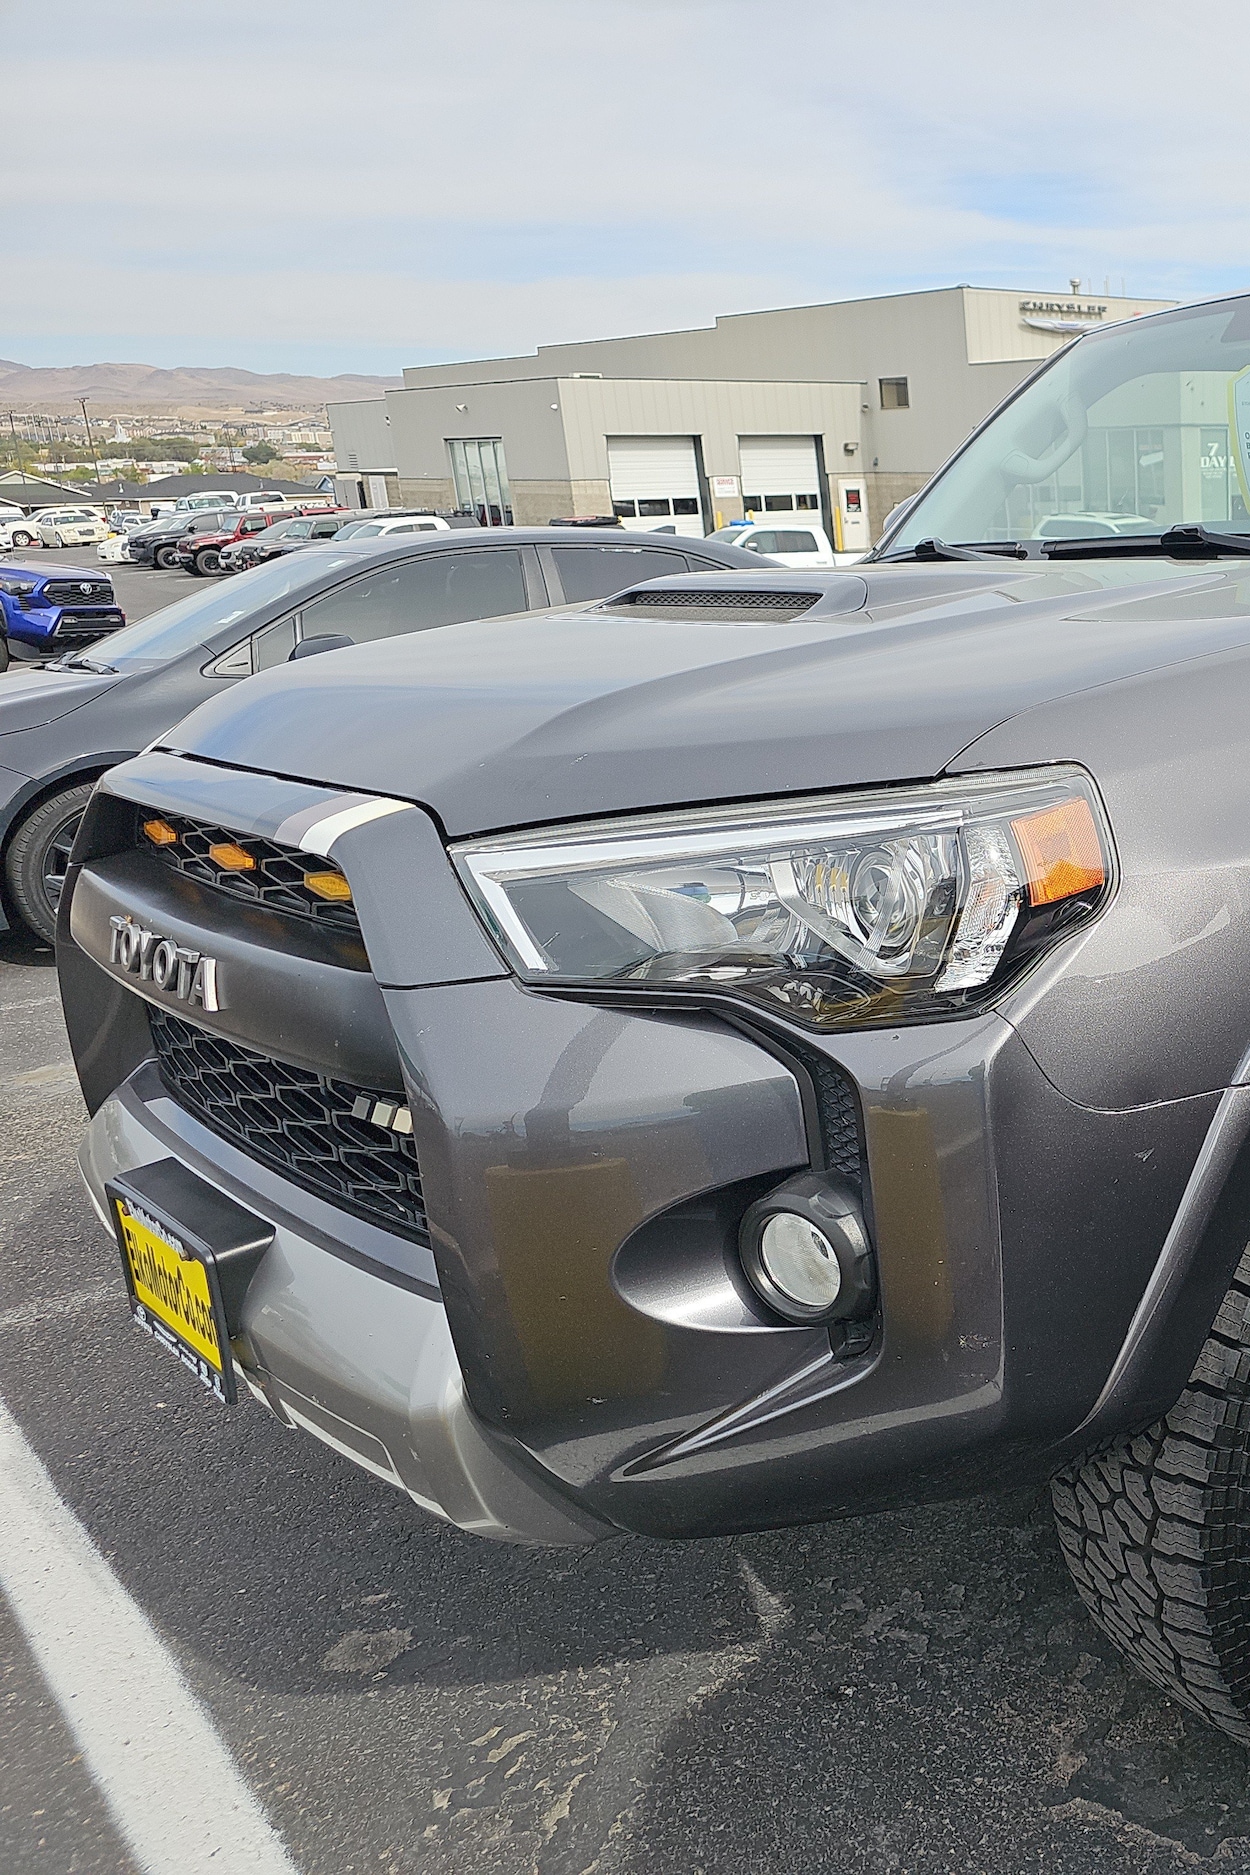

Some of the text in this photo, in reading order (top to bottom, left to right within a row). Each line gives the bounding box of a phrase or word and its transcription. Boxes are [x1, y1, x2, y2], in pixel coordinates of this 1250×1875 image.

[1018, 300, 1107, 314] CHRYSLER
[1207, 442, 1219, 457] 7
[1200, 456, 1227, 468] DAY
[109, 915, 219, 1012] TOYOTA
